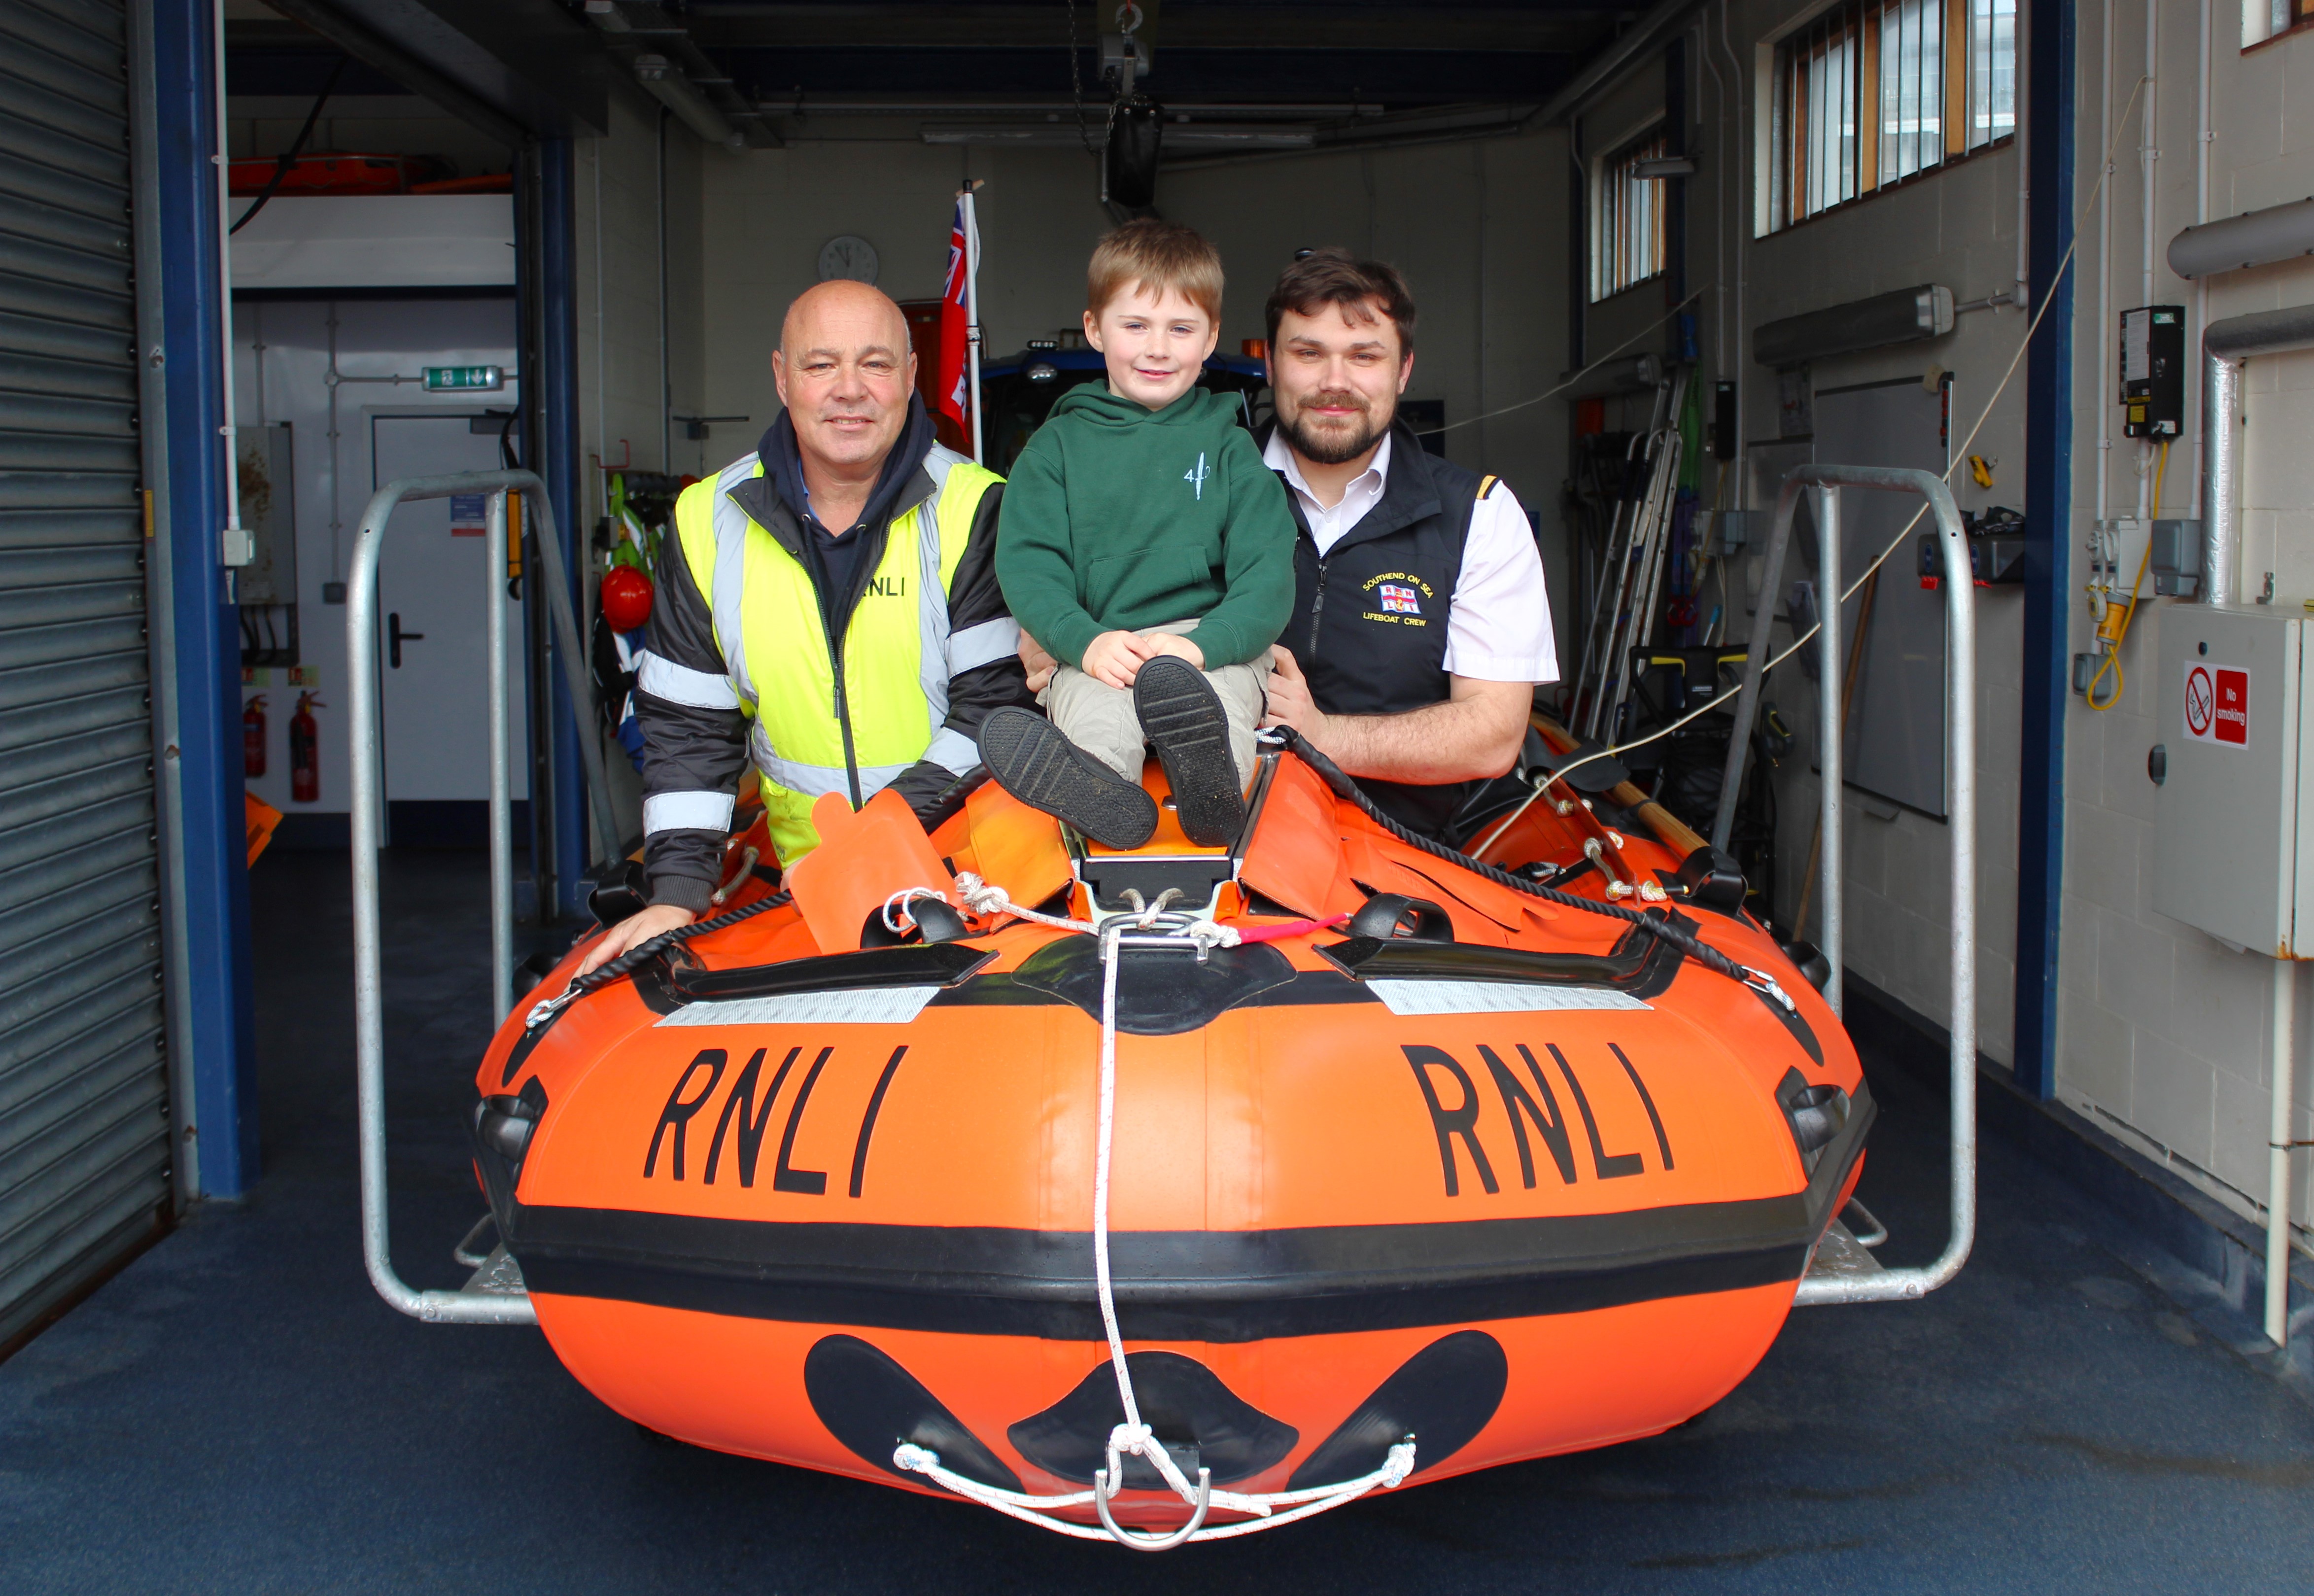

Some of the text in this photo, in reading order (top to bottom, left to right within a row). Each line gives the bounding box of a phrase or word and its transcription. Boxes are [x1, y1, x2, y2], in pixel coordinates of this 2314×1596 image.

[863, 577, 904, 596] NLI
[1362, 572, 1434, 598] SOUTHEND ON SEA
[1363, 612, 1426, 626] LIFEBOAT CREW
[2226, 687, 2237, 702] No
[2217, 708, 2245, 726] smoking
[644, 1045, 908, 1198] RNLI
[1400, 1042, 1675, 1197] RNLI
